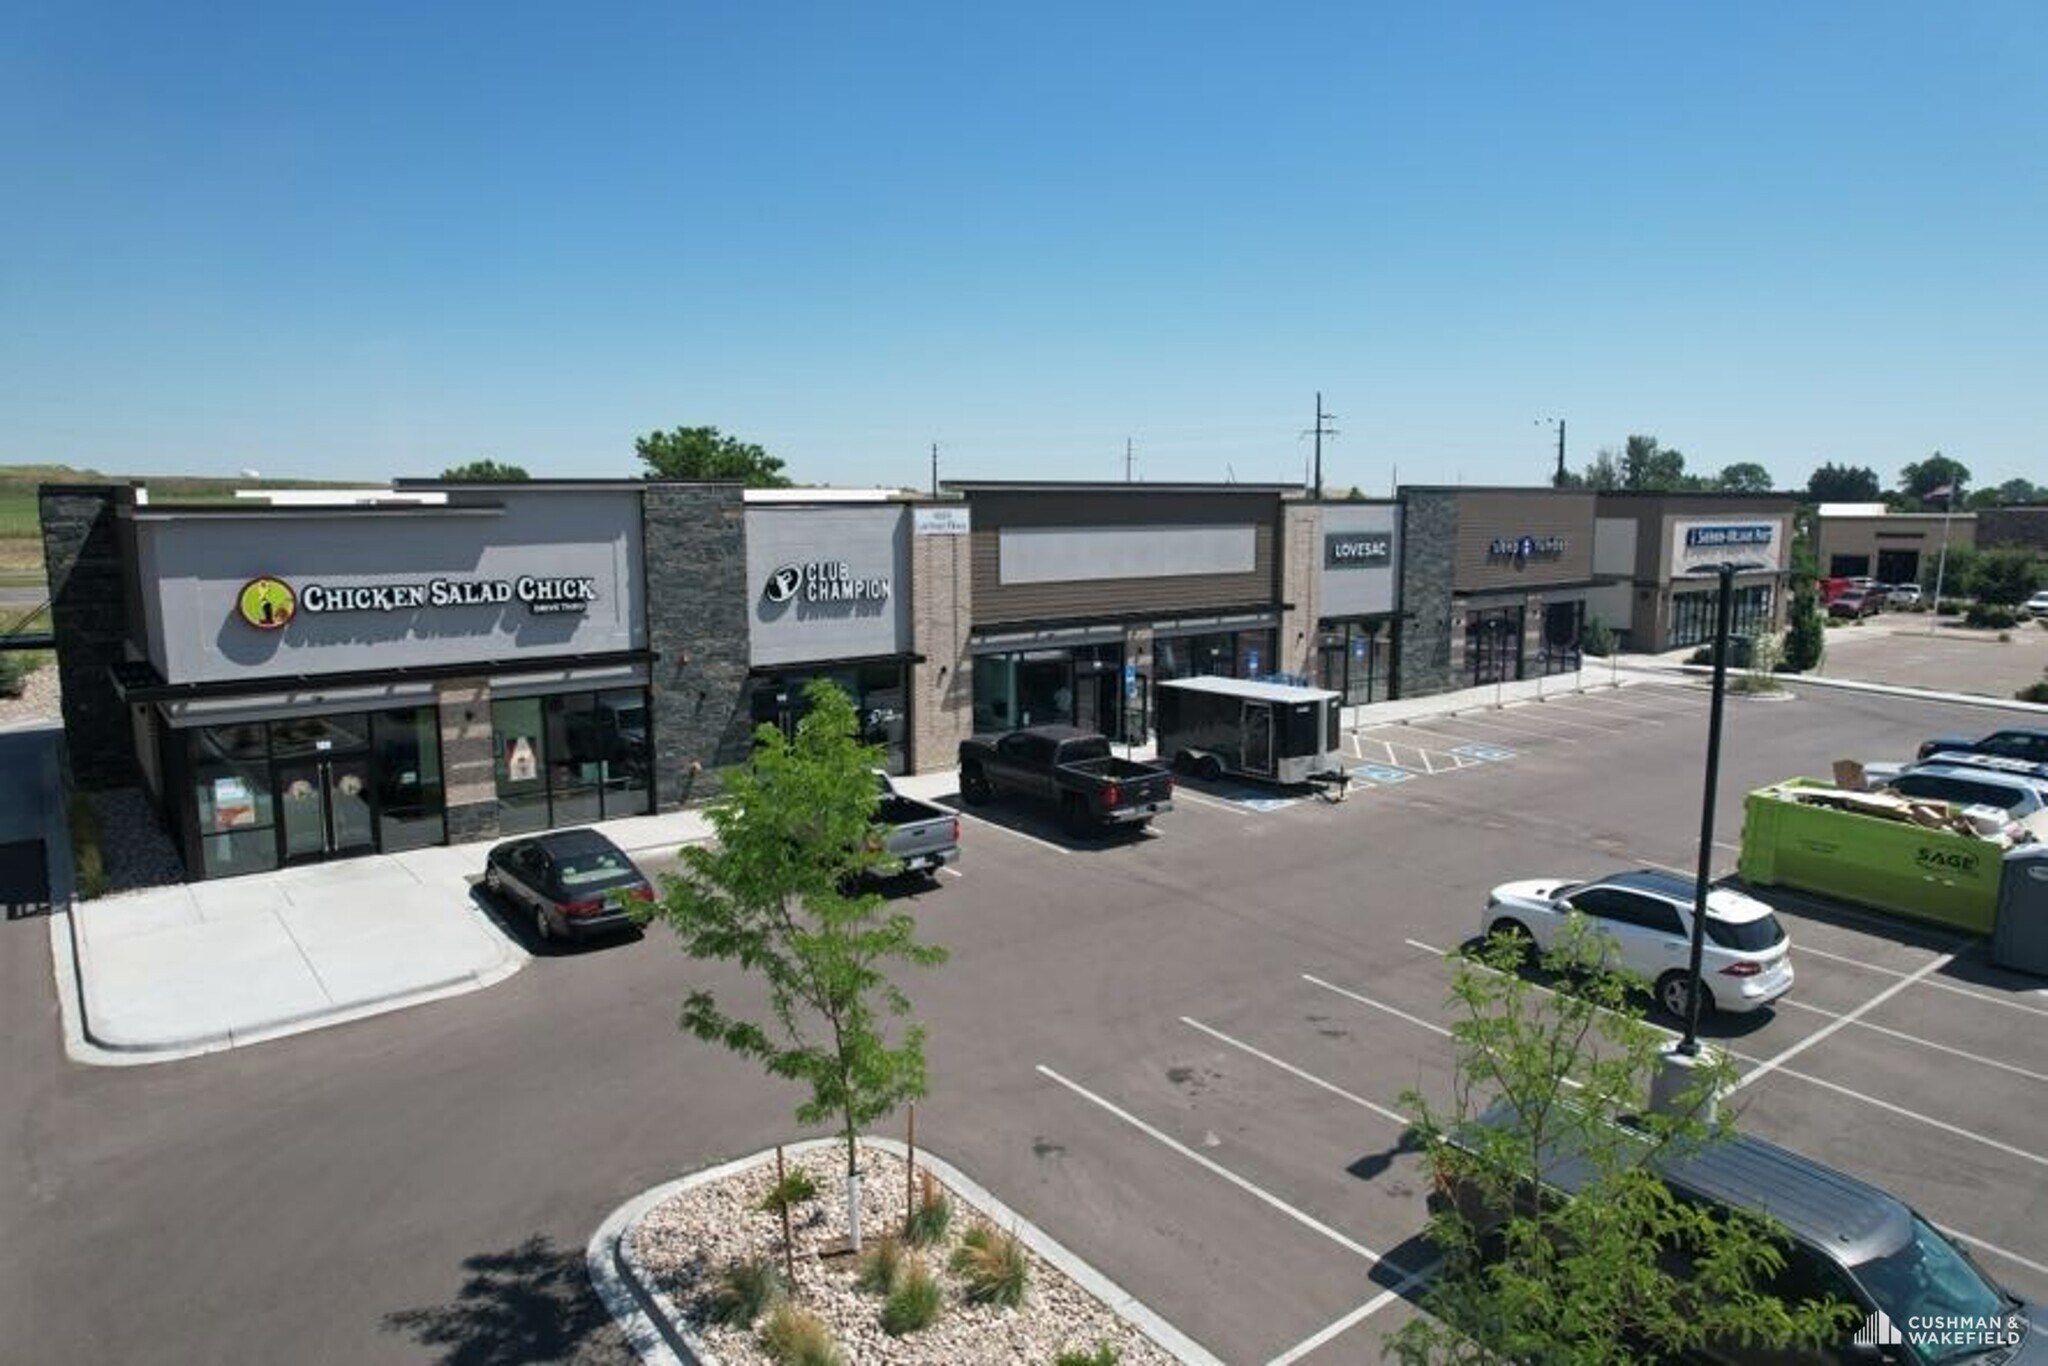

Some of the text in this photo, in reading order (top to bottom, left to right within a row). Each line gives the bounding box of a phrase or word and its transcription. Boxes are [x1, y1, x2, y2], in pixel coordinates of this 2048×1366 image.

[1335, 542, 1386, 557] LOVESAC
[805, 563, 849, 581] CLUB
[303, 577, 595, 612] CHICKEN SALAD CHICK
[807, 580, 891, 602] CHAMPION
[1916, 849, 1979, 870] SAGE
